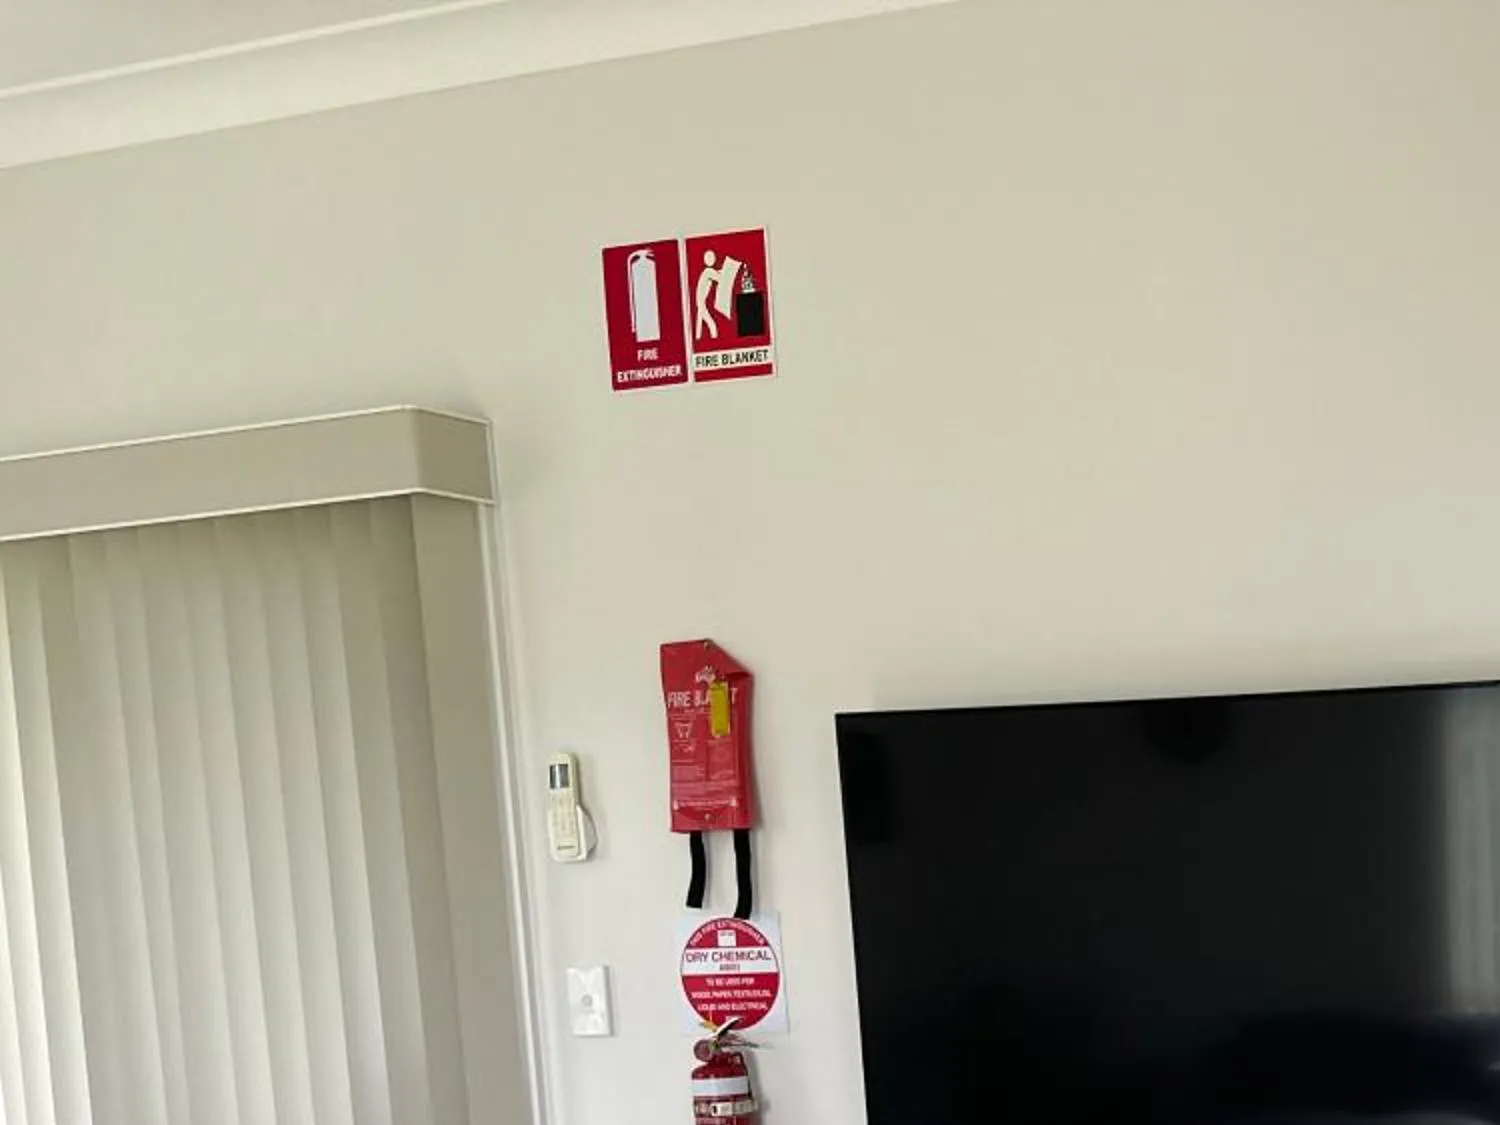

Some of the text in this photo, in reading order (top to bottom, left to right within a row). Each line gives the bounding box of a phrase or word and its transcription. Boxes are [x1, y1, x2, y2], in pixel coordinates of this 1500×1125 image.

[637, 348, 659, 361] FIRE
[696, 349, 769, 367] FIRE BLANKET
[617, 365, 682, 382] EXTINGUISHER
[667, 690, 691, 708] FIRE
[686, 949, 772, 963] DRY CHEMICAL
